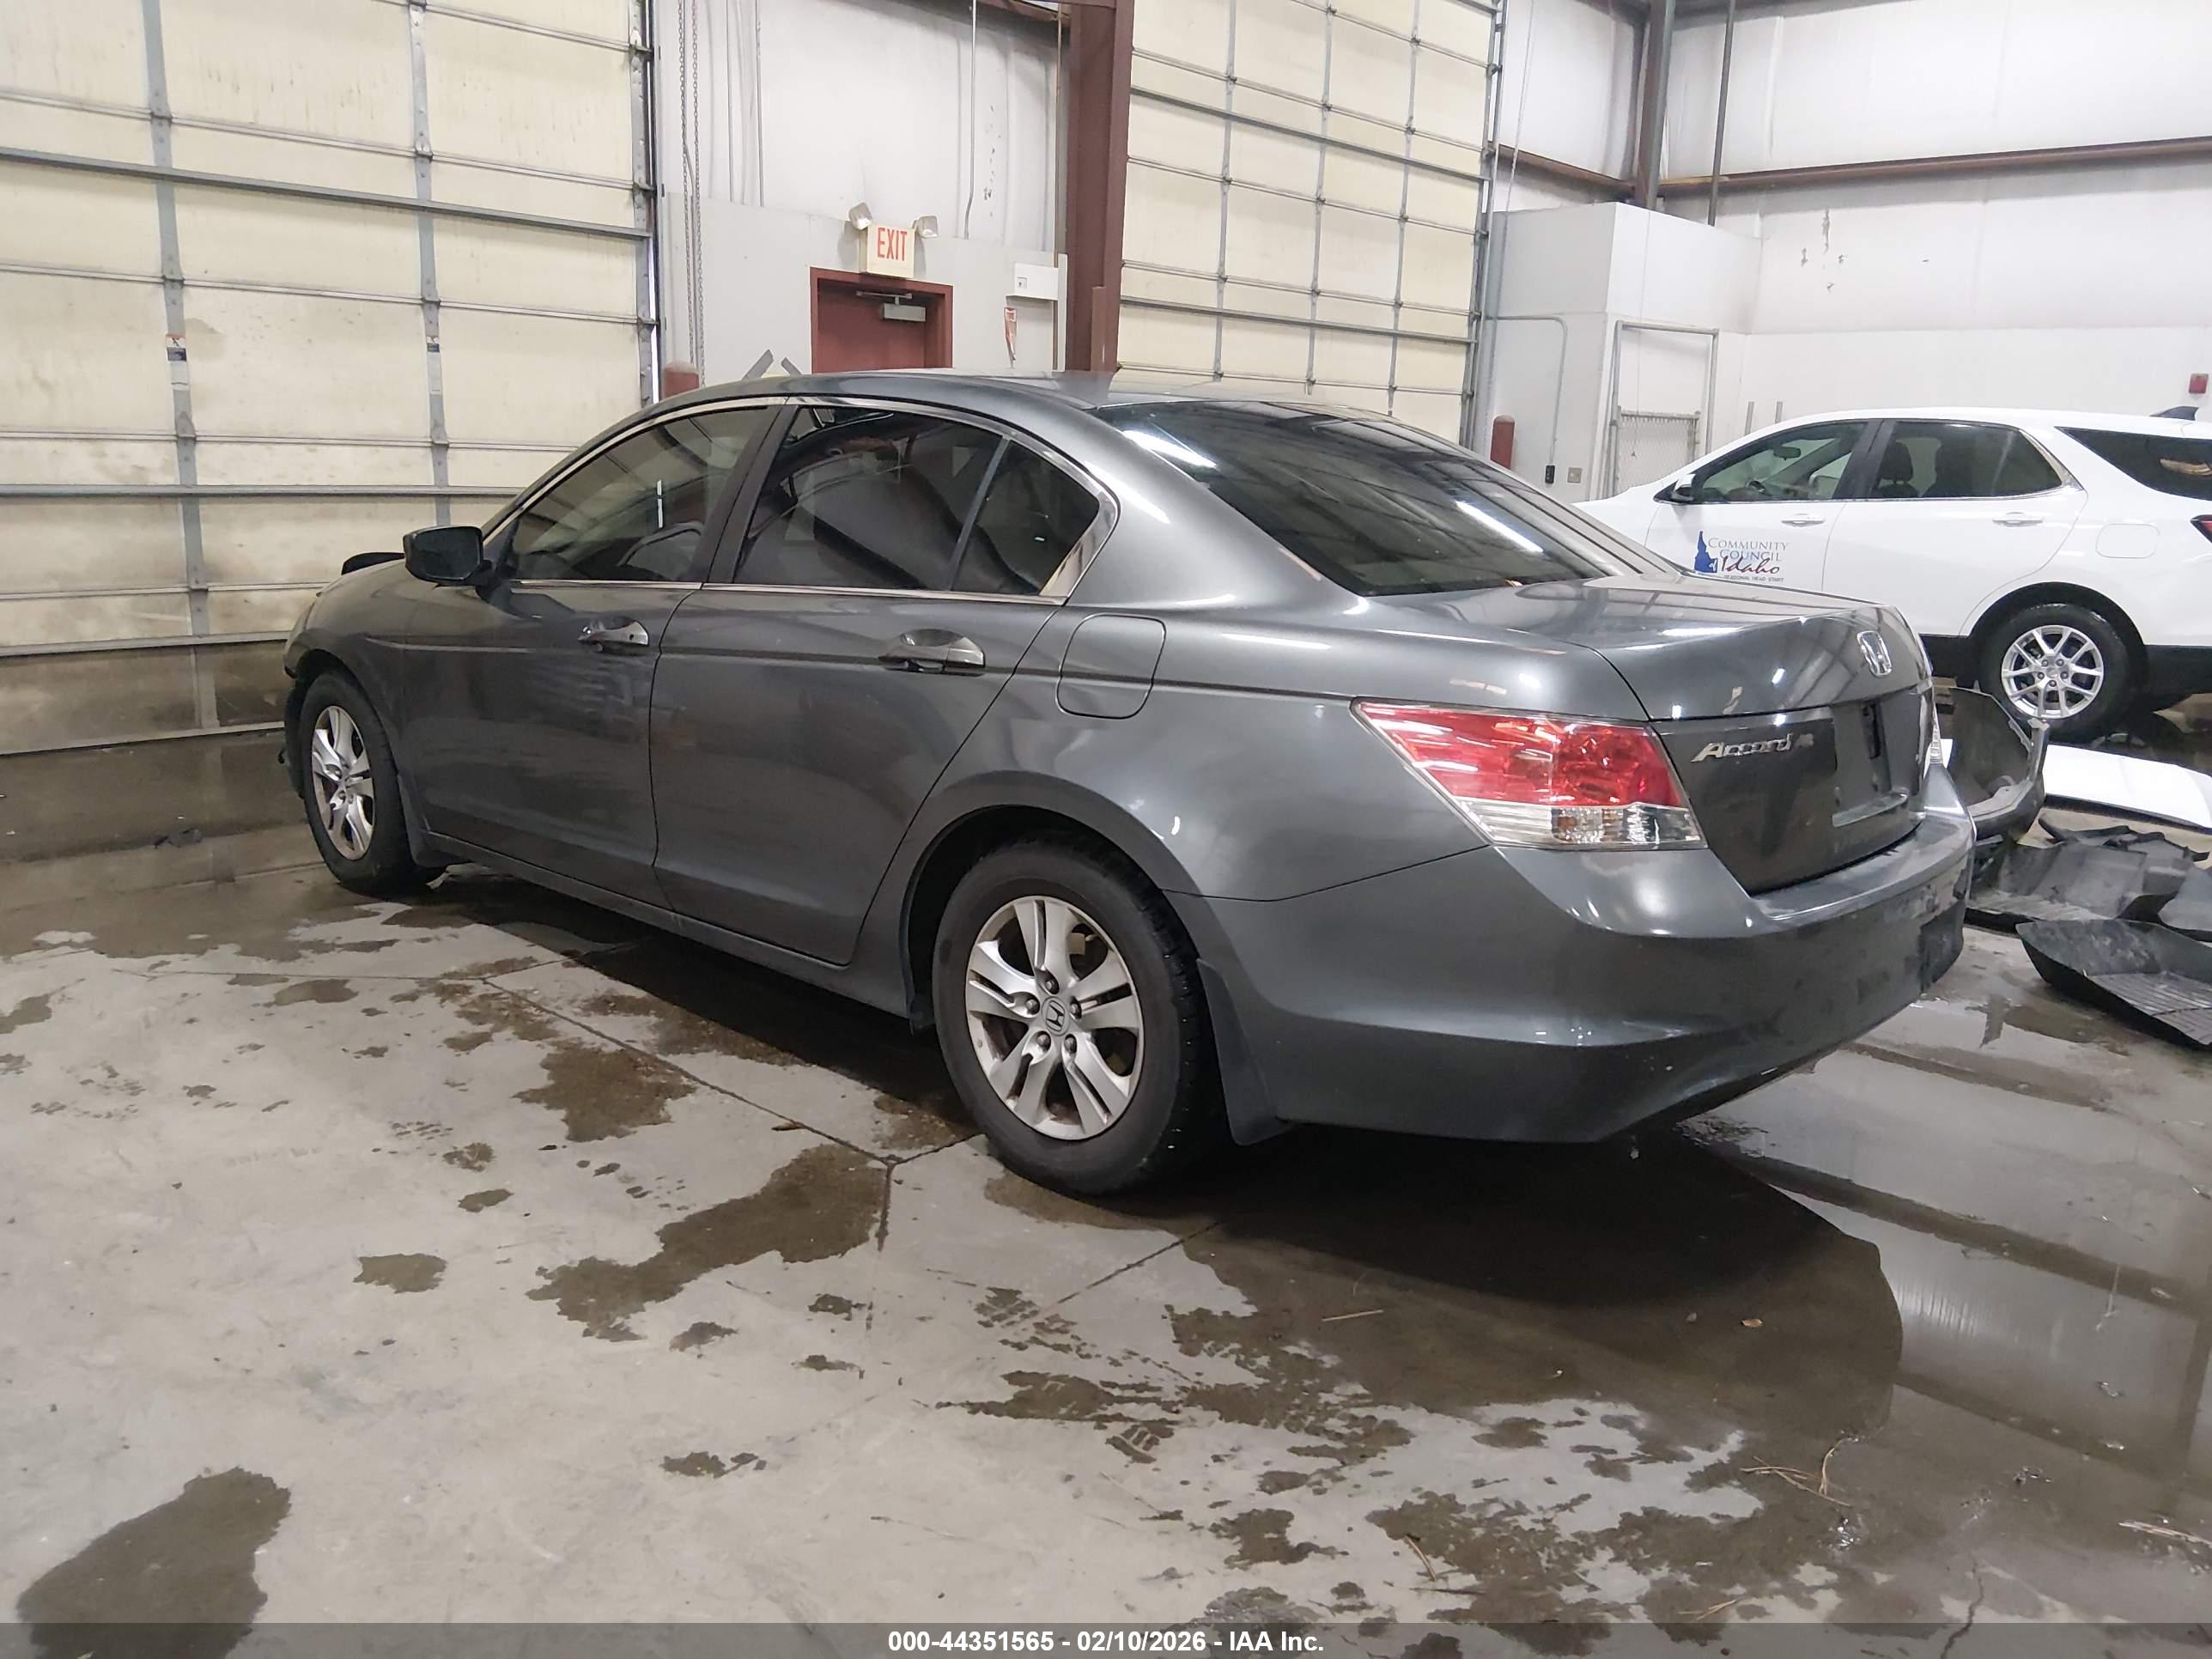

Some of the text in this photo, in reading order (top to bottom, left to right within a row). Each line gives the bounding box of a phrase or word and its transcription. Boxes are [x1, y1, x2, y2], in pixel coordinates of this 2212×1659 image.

[878, 228, 907, 261] EXIT
[1708, 538, 1789, 550] COMMUNITY
[1720, 550, 1784, 562] COUNCIL
[1721, 555, 1780, 574] Idaho
[1690, 732, 1793, 763] Accord
